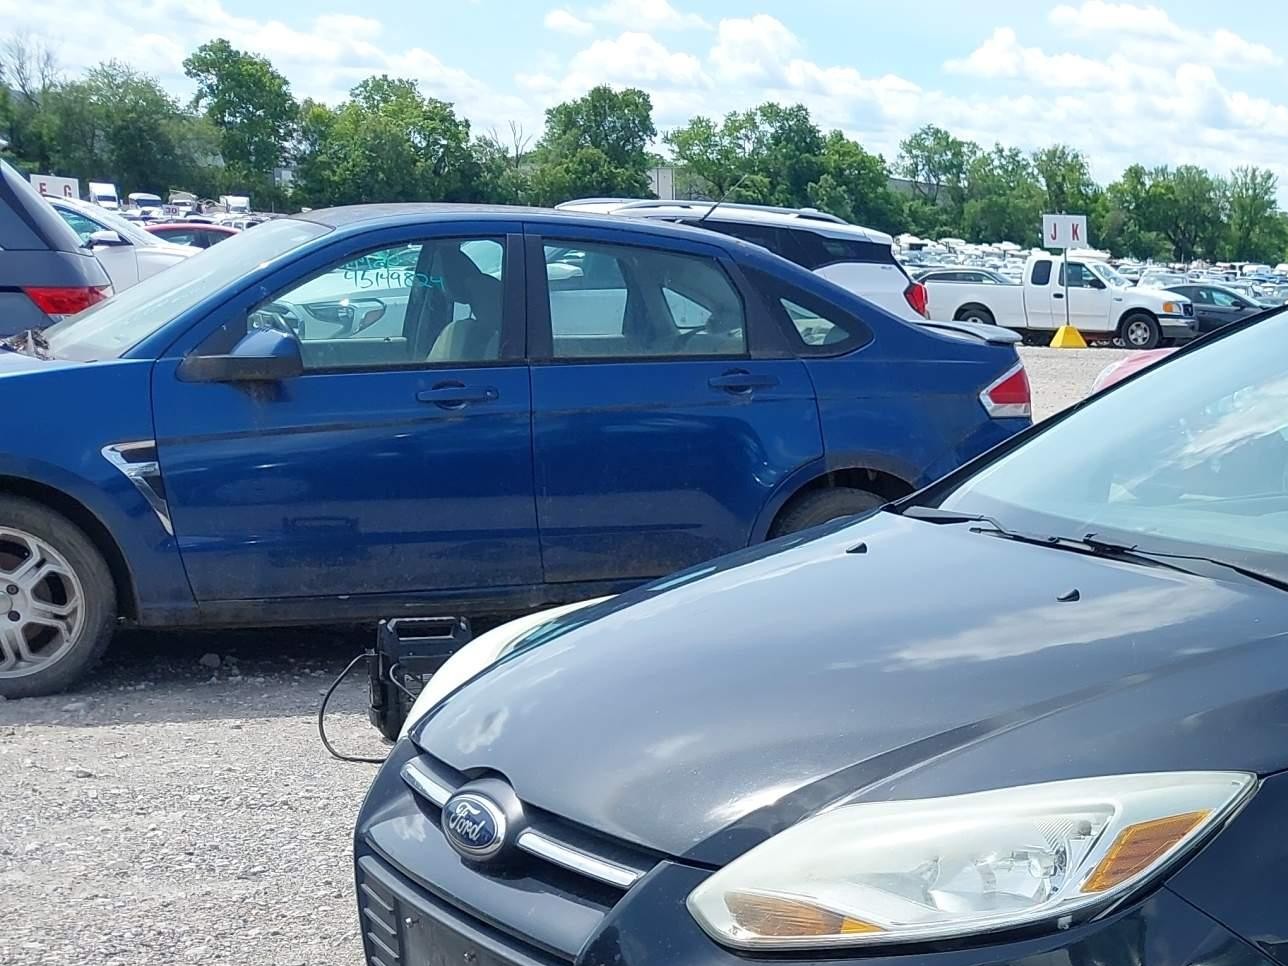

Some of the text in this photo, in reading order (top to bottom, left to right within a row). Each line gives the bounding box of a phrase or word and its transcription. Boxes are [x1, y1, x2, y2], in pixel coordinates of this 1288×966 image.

[1050, 222, 1080, 241] J K
[448, 801, 487, 841] Ford
